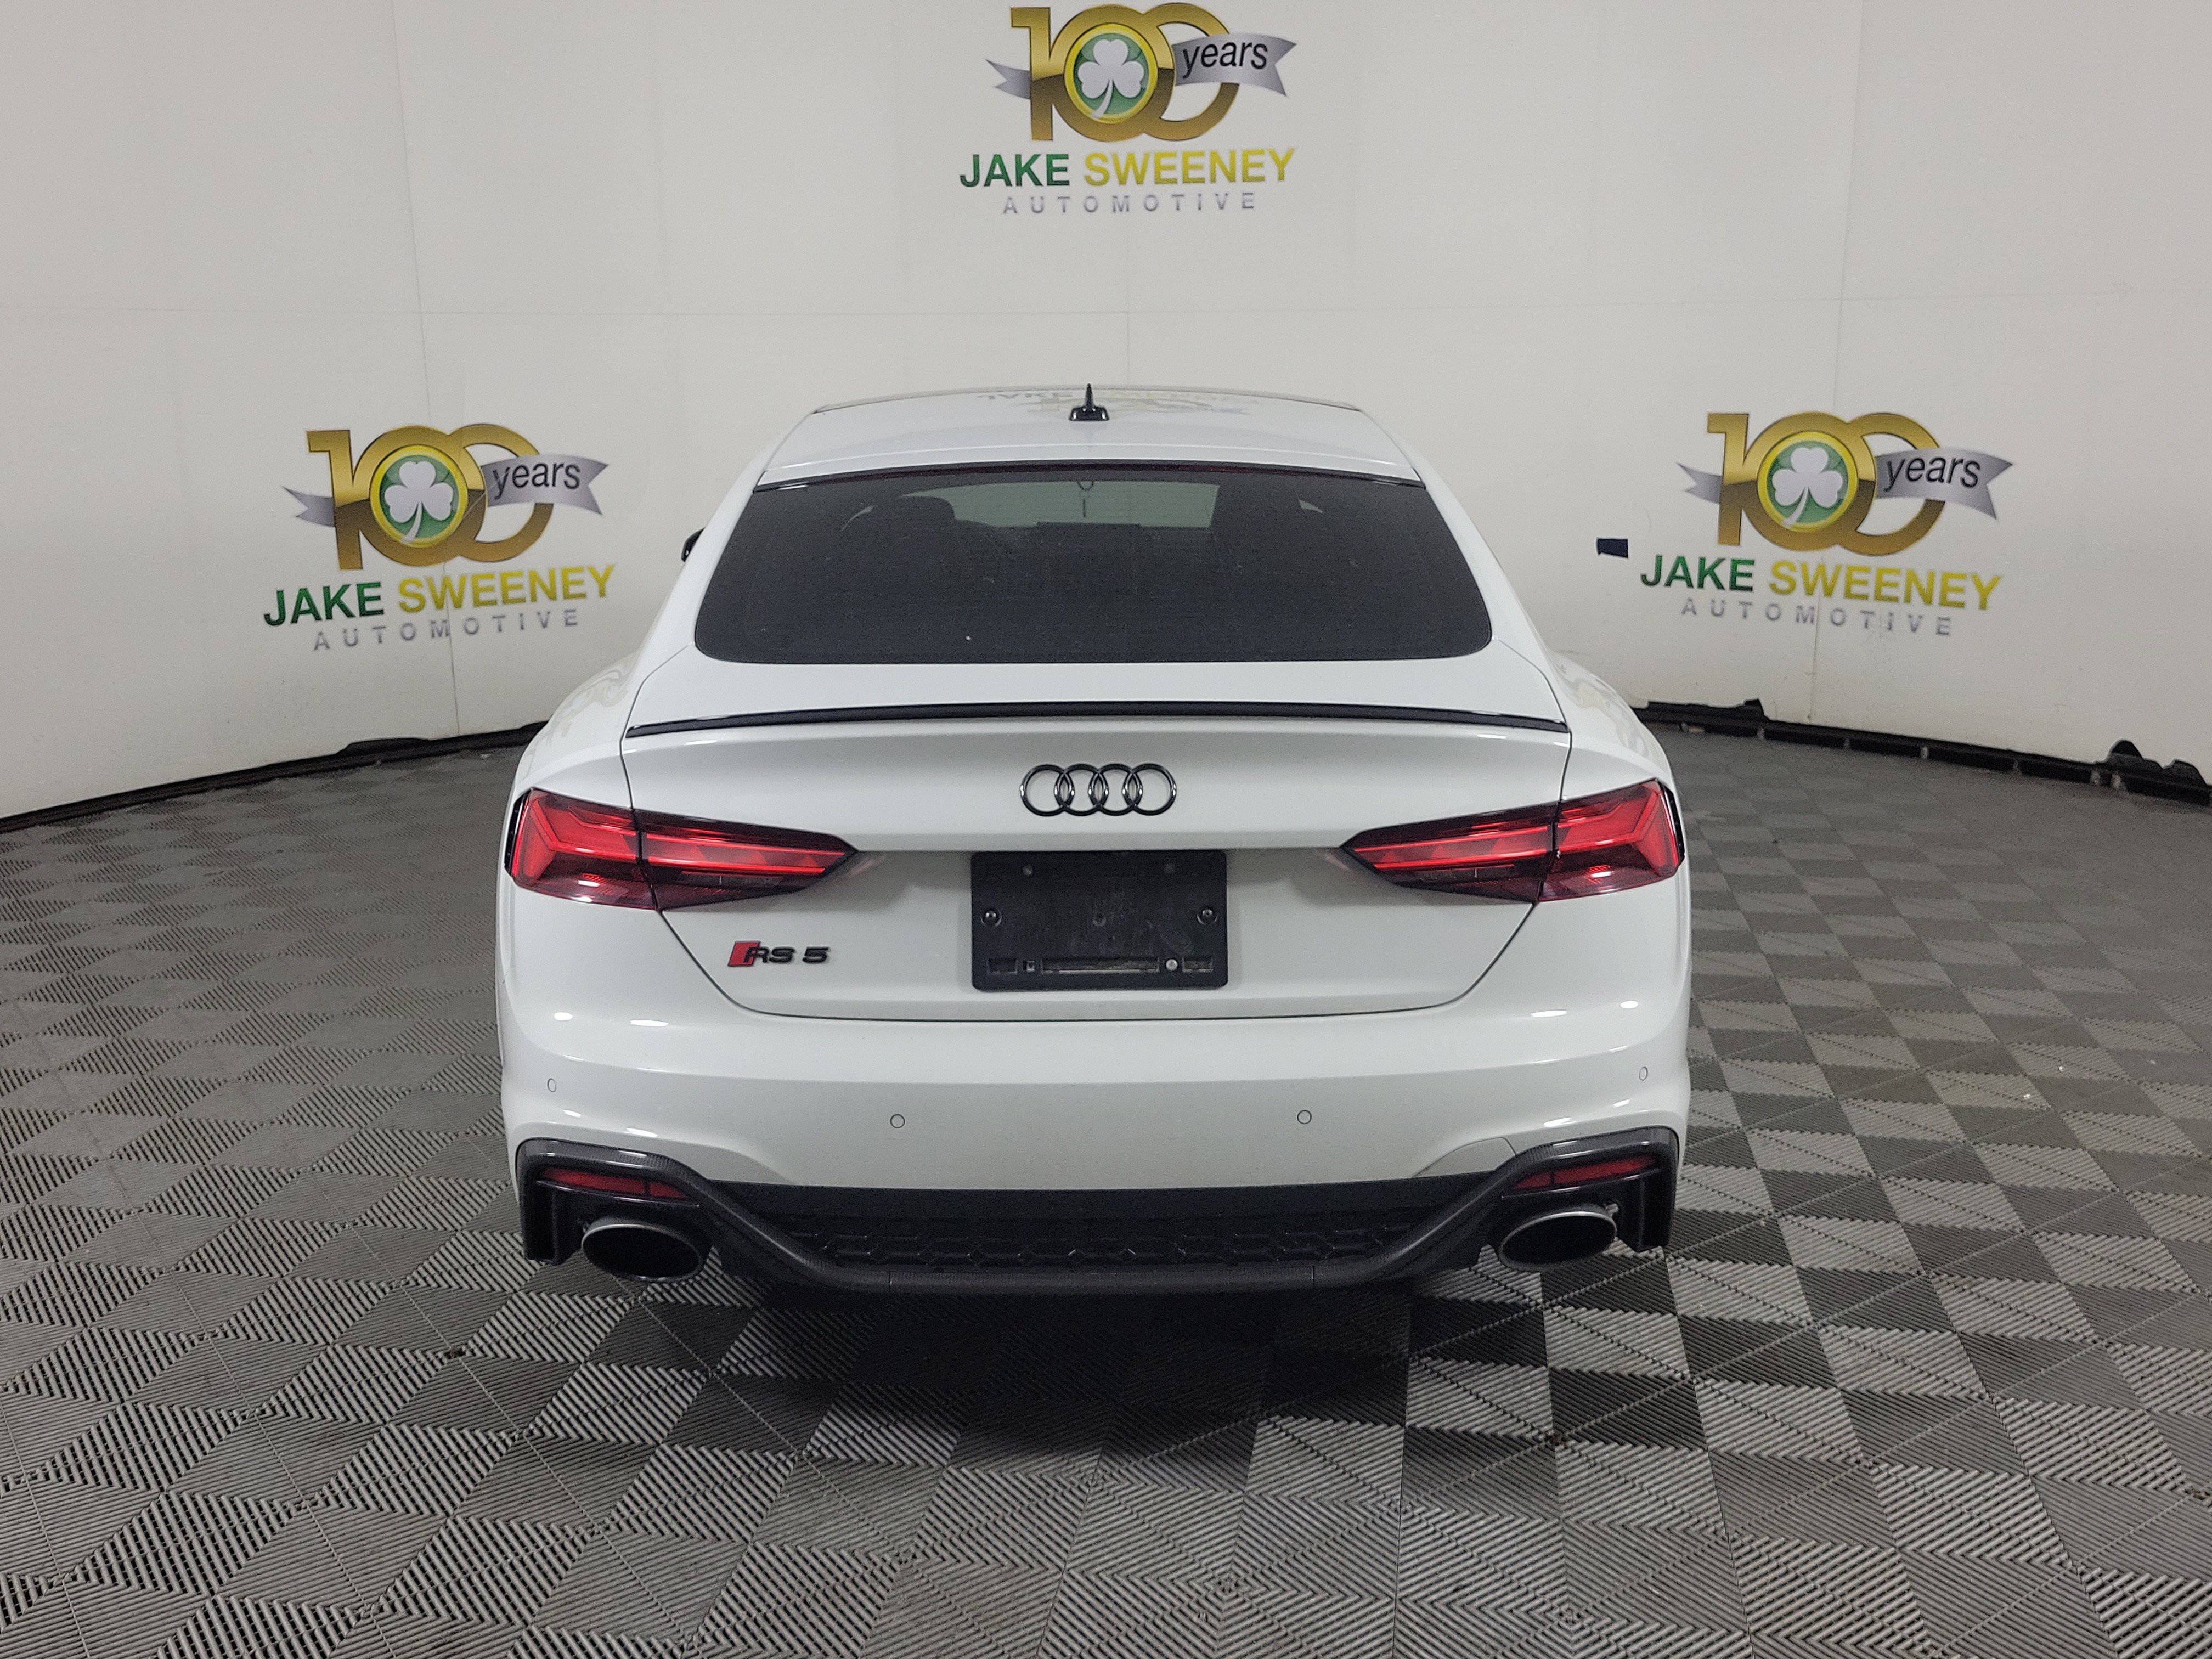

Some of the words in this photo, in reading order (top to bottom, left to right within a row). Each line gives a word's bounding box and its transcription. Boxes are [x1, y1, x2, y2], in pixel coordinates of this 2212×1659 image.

[1011, 3, 1239, 142] 100
[1182, 41, 1268, 79] years
[960, 154, 1070, 187] JAKE
[1084, 147, 1296, 186] SWEENEY
[1003, 192, 1255, 214] AUTOMOTIVE
[306, 424, 554, 571] 100
[493, 462, 580, 500] years
[1707, 411, 1945, 556] 100
[1883, 453, 1982, 492] years
[263, 582, 384, 627] JAKE
[398, 565, 615, 614] SWEENEY
[1640, 555, 1756, 592] JAKE
[1769, 560, 2004, 611] SWEENEY
[313, 609, 578, 651] AUTOMOTIVE
[1681, 598, 1951, 637] AUTOMOTIVE
[742, 946, 795, 963] RS
[802, 946, 830, 963] 5
